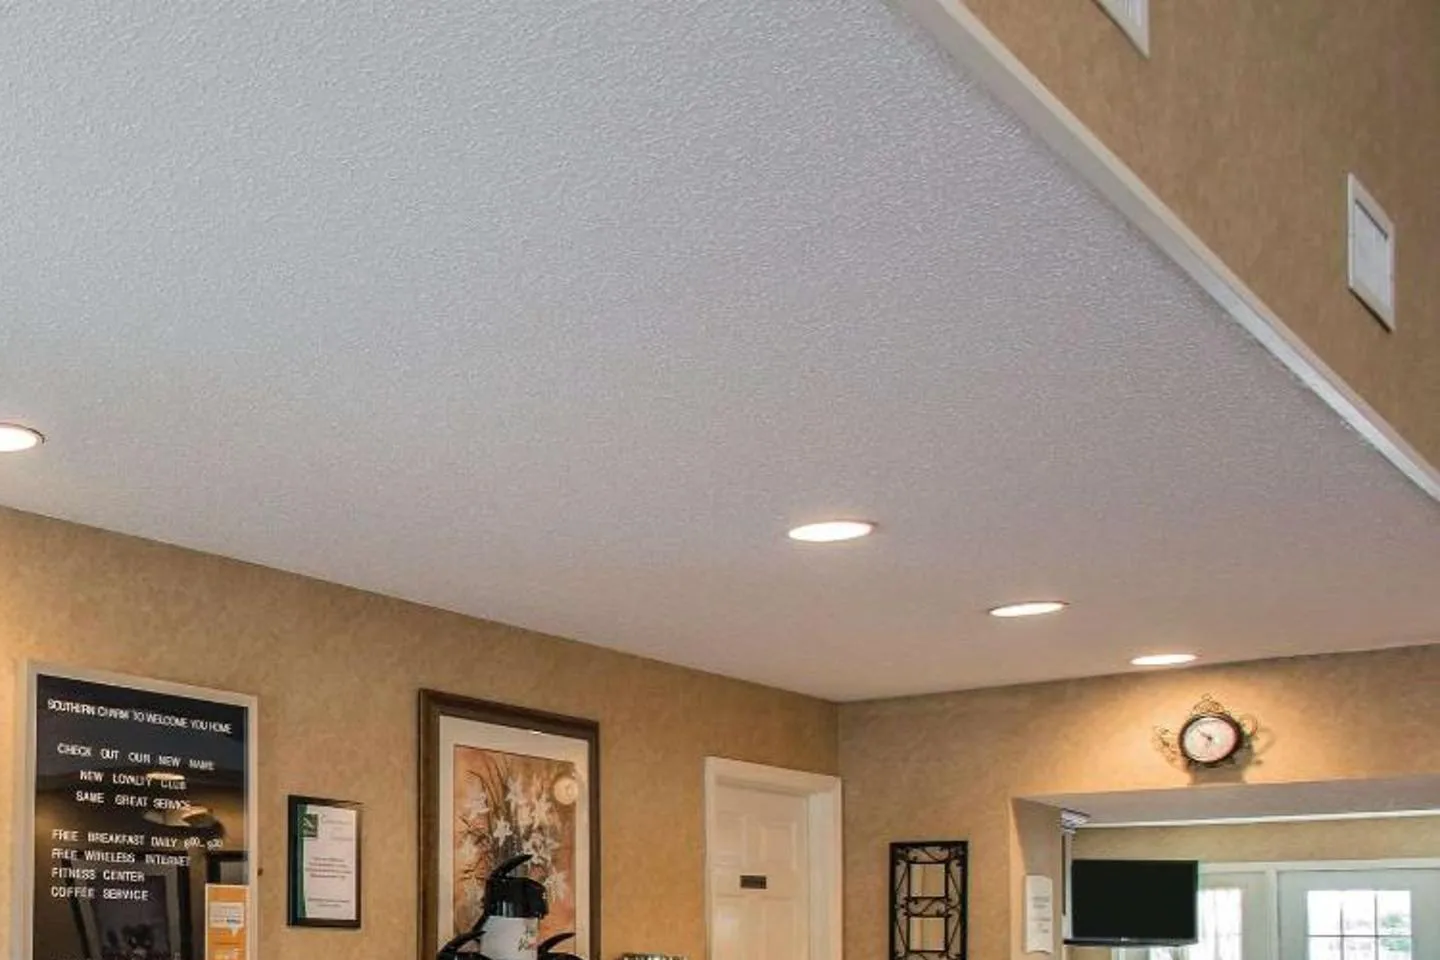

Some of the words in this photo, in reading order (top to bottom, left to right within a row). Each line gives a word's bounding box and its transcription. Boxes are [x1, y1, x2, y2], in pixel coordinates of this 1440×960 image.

[47, 699, 96, 716] SOUTHERN
[97, 706, 130, 720] CHARM
[133, 710, 145, 723] TO
[146, 712, 189, 729] WELCOME
[190, 719, 209, 731] YOU
[209, 721, 233, 734] HOME
[57, 742, 92, 757] CHECK
[100, 748, 120, 760] OUT
[128, 751, 151, 764] OUR
[159, 755, 181, 768] NEW
[189, 758, 215, 771] NAME
[80, 769, 104, 782] NEW
[112, 773, 153, 787] LOYALTY
[161, 778, 187, 790] CLUB
[76, 790, 105, 804] SAME
[114, 794, 149, 808] GREAT
[51, 829, 79, 842] FREE
[87, 831, 145, 846] BREAKFAST
[151, 836, 178, 848] DAILY
[51, 848, 78, 860] FREE
[84, 849, 136, 864] WIRELESS
[145, 853, 191, 867] INTERNET
[51, 868, 96, 881] FITNESS
[103, 870, 145, 883] CENTER
[51, 886, 95, 899] COFFEE
[103, 888, 149, 901] SERVICE
